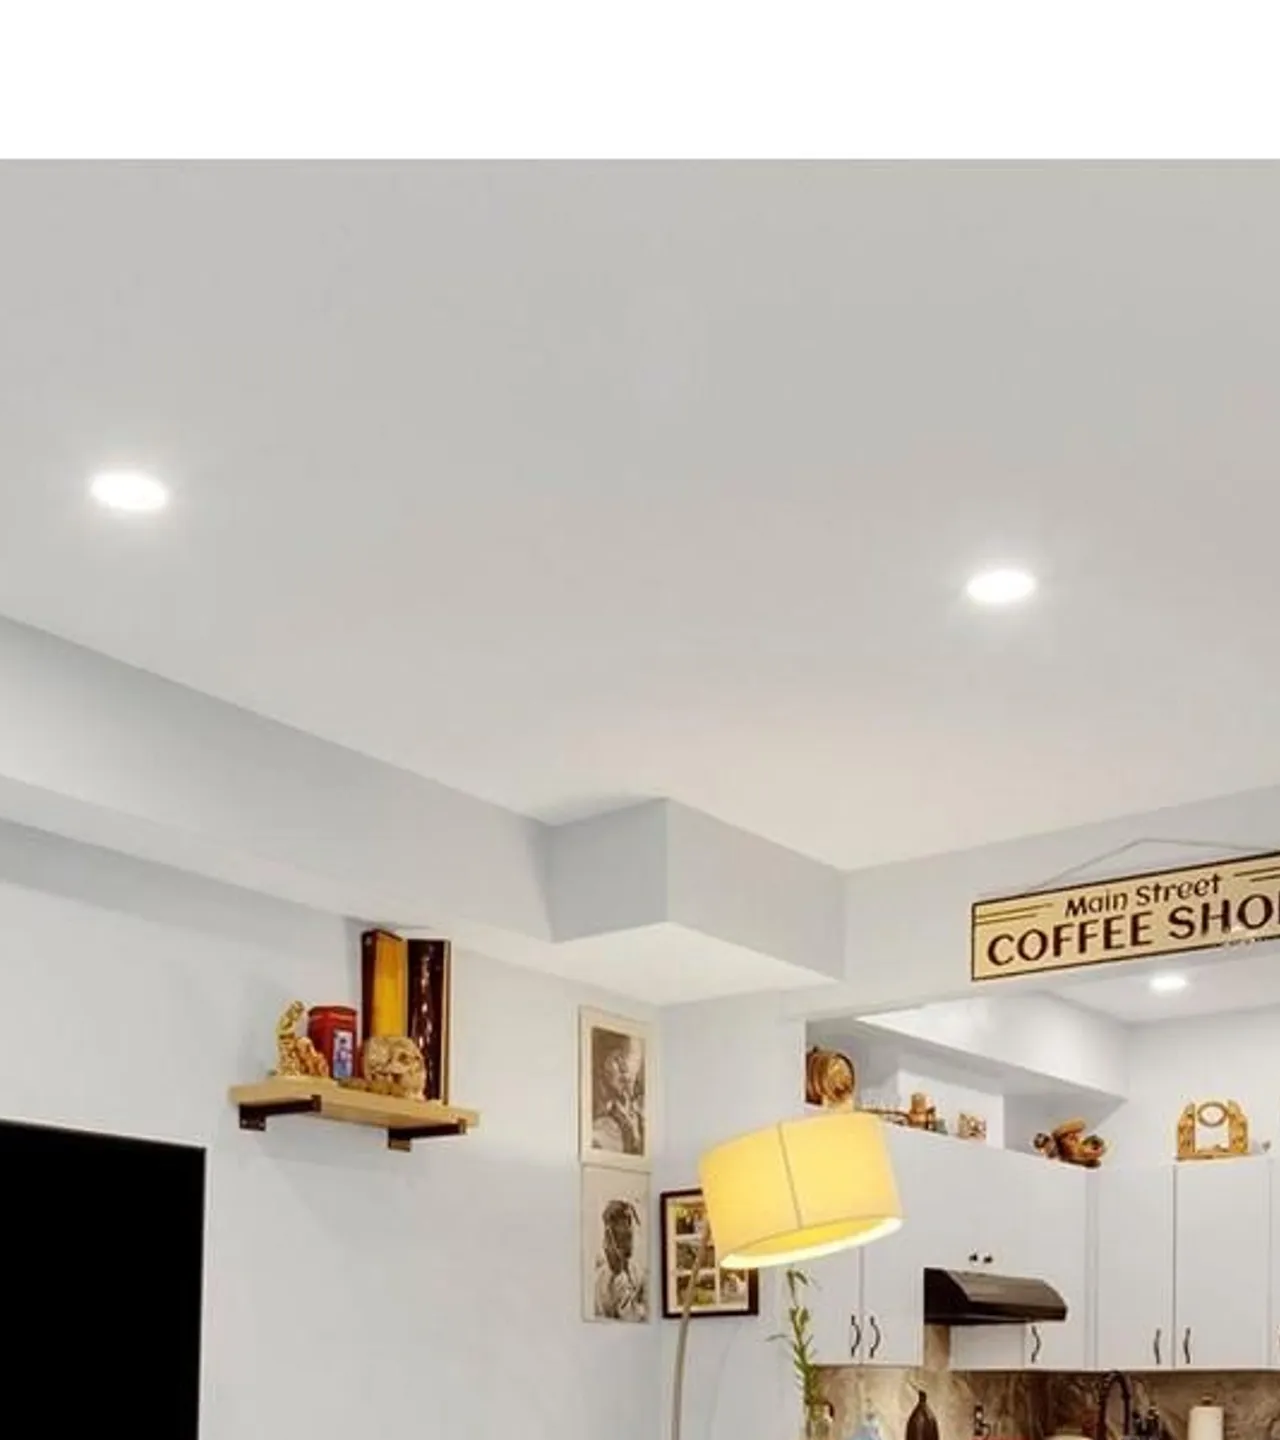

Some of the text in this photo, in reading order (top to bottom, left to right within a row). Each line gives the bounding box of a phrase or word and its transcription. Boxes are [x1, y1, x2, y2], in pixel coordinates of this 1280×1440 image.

[1064, 873, 1222, 917] Main Street
[986, 911, 1153, 966] COFFEE
